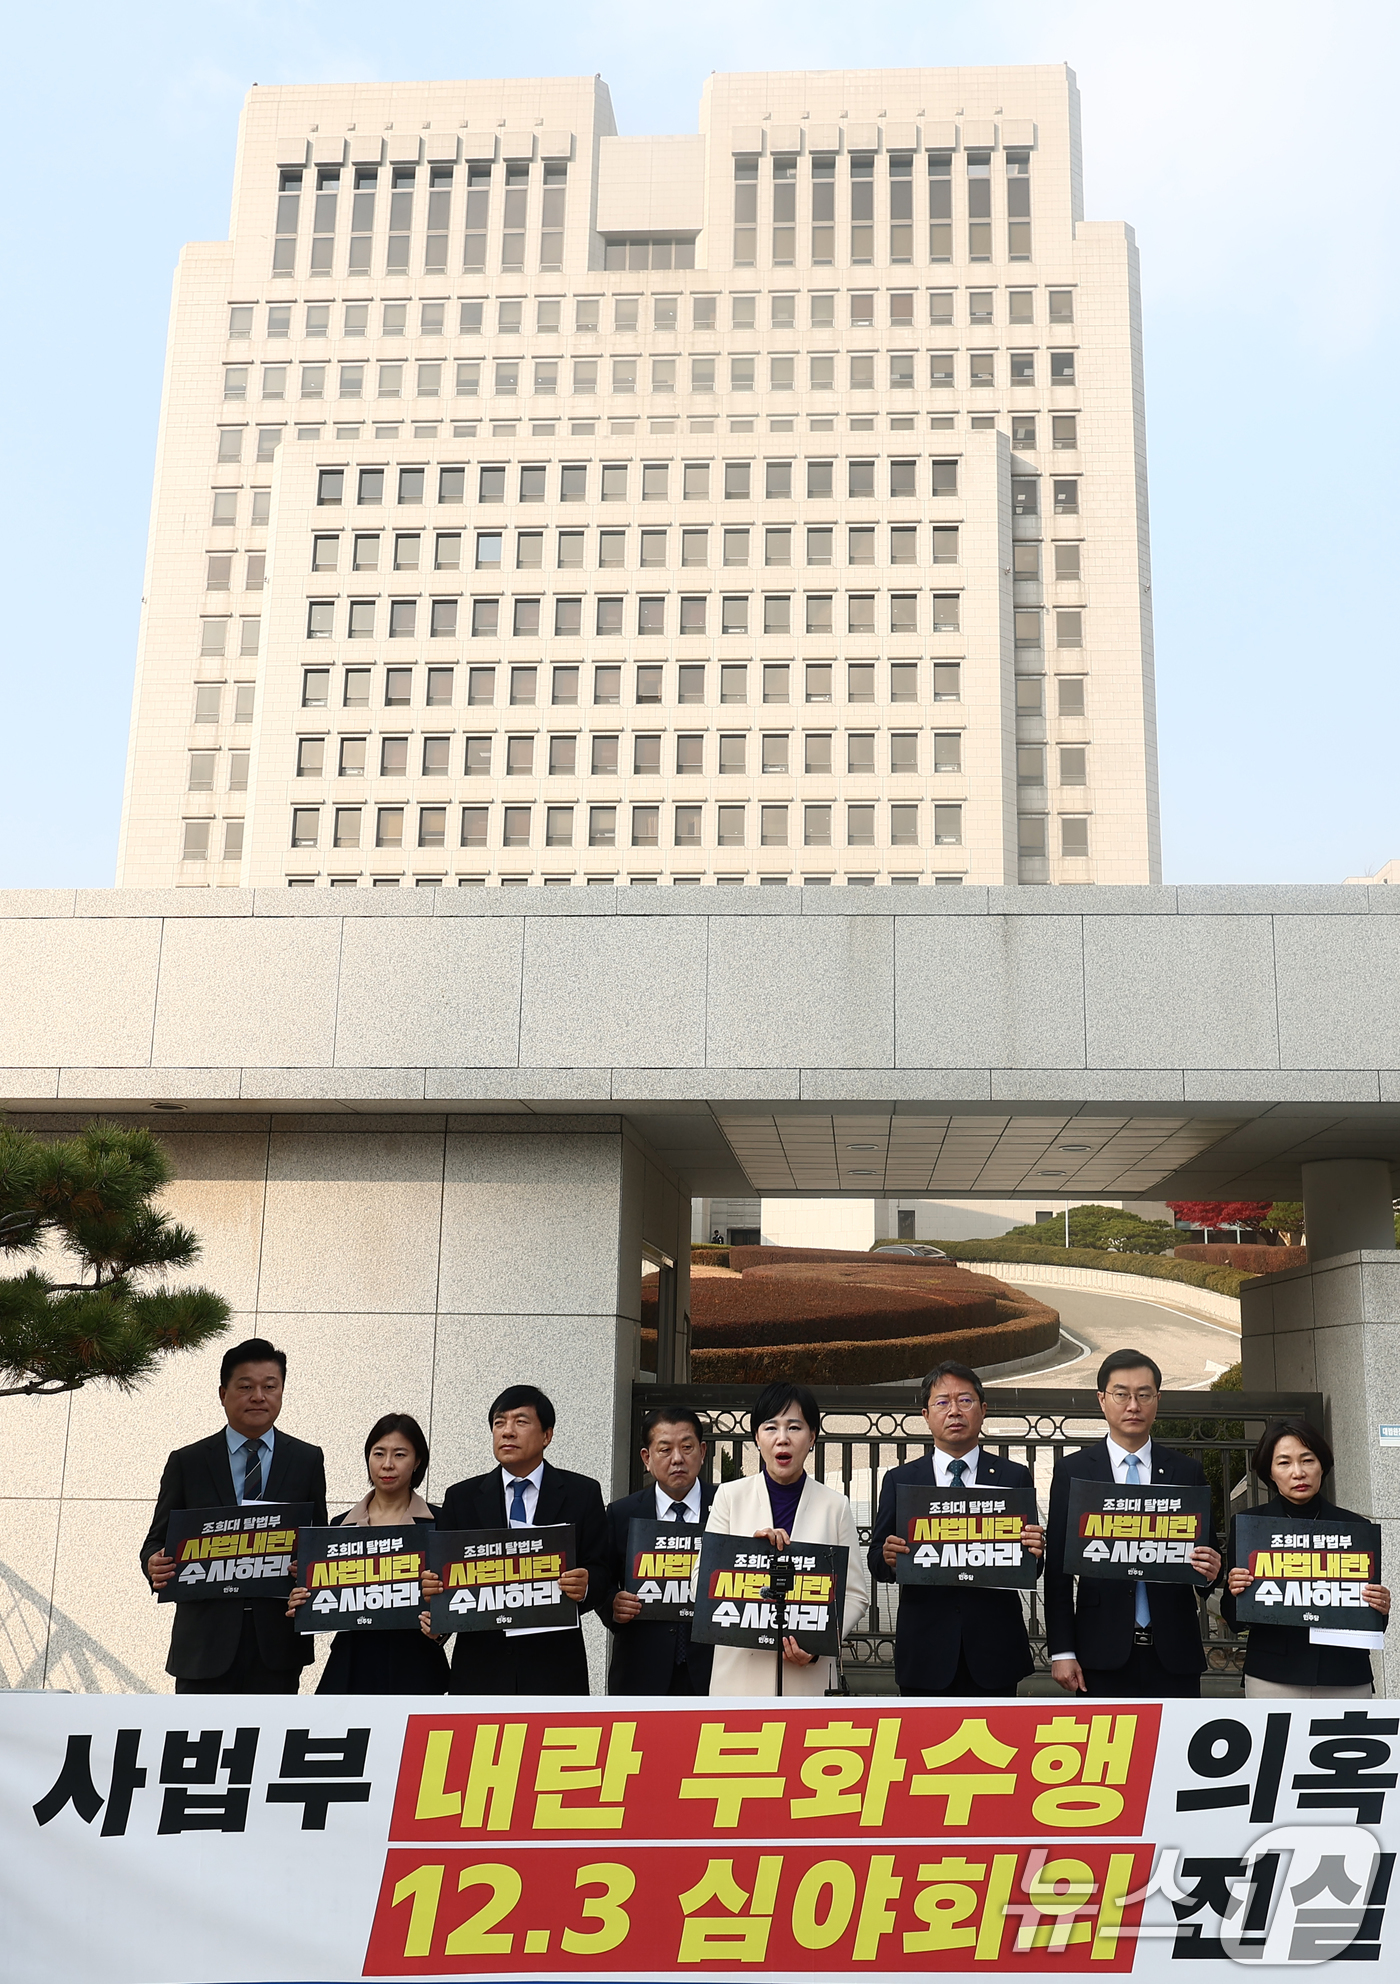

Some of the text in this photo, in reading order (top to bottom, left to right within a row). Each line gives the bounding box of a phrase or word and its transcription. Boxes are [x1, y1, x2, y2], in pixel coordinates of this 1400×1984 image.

[929, 1500, 1006, 1514] 조희대 탈법부
[1102, 1498, 1181, 1512] 조희대 탈법부
[201, 1515, 281, 1534] 조희대 탈법부
[913, 1516, 1023, 1541] 사법내란
[1084, 1514, 1197, 1539] 사법내란
[181, 1530, 296, 1560] 사법내란
[327, 1538, 403, 1557] 조희대 탈법부
[464, 1539, 543, 1558] 조희대 탈법부
[654, 1536, 691, 1550] 조희대
[1083, 1539, 1195, 1564] 수사하라
[1270, 1534, 1352, 1549] 조희대 탈법부
[637, 1553, 699, 1577] 사법
[913, 1542, 1023, 1568] 수사하라
[1254, 1552, 1370, 1578] 사법내란
[178, 1555, 292, 1584] 수사하라
[311, 1554, 421, 1587] 사법내란
[448, 1554, 561, 1587] 사법내란
[312, 1581, 421, 1614] 수사하라
[449, 1581, 562, 1614] 수사하라
[636, 1580, 690, 1604] 수사
[1255, 1580, 1369, 1607] 수사하라
[32, 1711, 1399, 1837] 사법부 내란 부화수행 의혹
[391, 1852, 1397, 1963] 12.3 심야회의 진실
